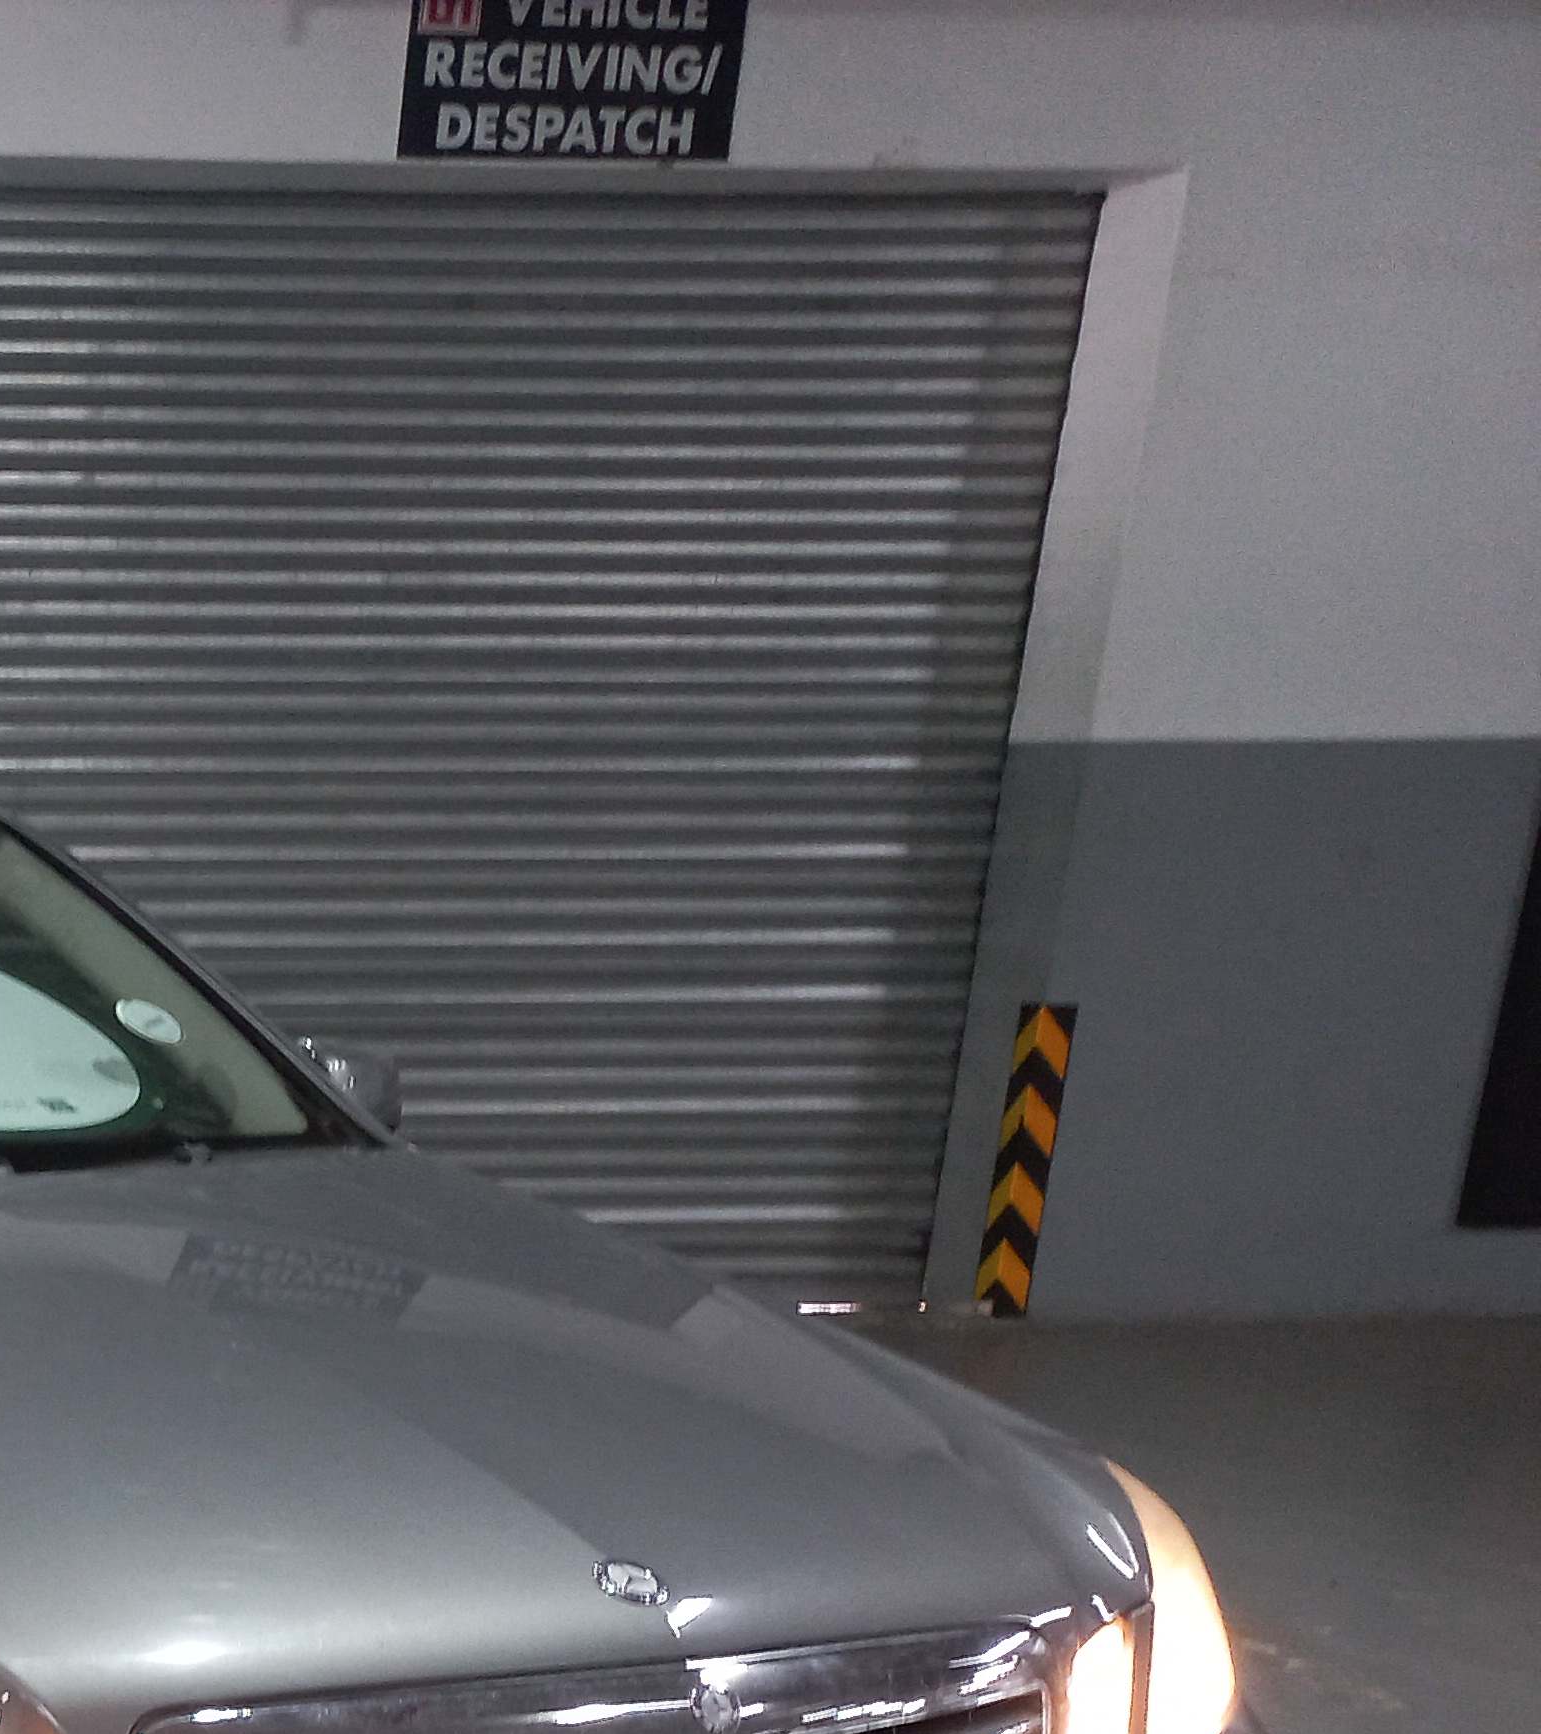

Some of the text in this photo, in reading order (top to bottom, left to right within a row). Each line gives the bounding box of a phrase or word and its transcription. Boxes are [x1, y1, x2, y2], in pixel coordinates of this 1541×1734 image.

[509, 0, 708, 31] VEHICLE
[423, 39, 723, 96] RECEIVING/
[436, 102, 696, 156] DESPATCH
